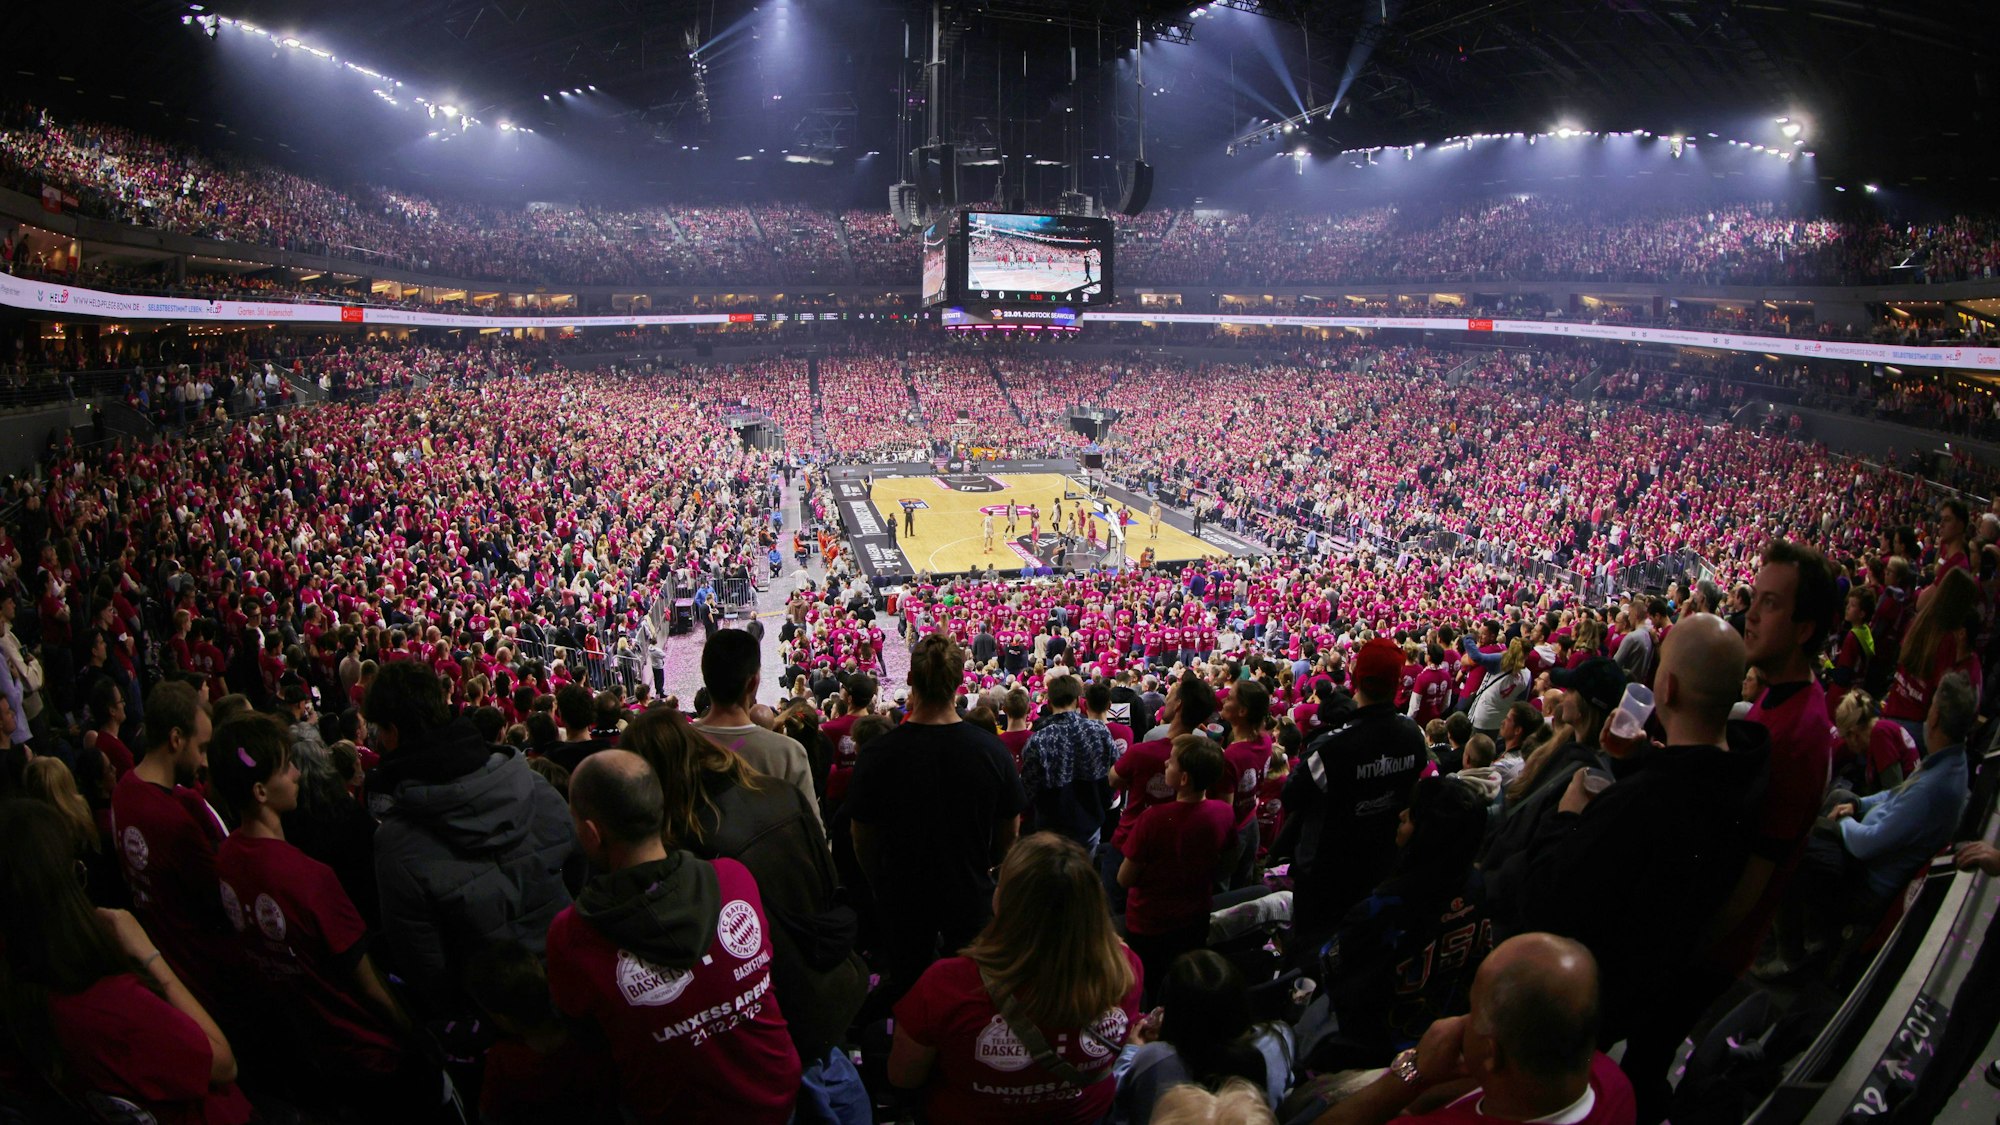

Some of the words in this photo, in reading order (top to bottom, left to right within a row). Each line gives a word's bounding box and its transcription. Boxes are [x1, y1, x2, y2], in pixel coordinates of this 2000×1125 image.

[998, 291, 1005, 299] 0
[1066, 293, 1072, 301] 4
[1051, 312, 1075, 320] SEAWOLVES
[1356, 762, 1381, 780] MTV
[725, 904, 754, 919] BAYERN
[722, 920, 729, 933] FC
[652, 1001, 733, 1042] LANXESS
[691, 1002, 762, 1046] 21.12.2025
[972, 1080, 1055, 1096] LANXESS
